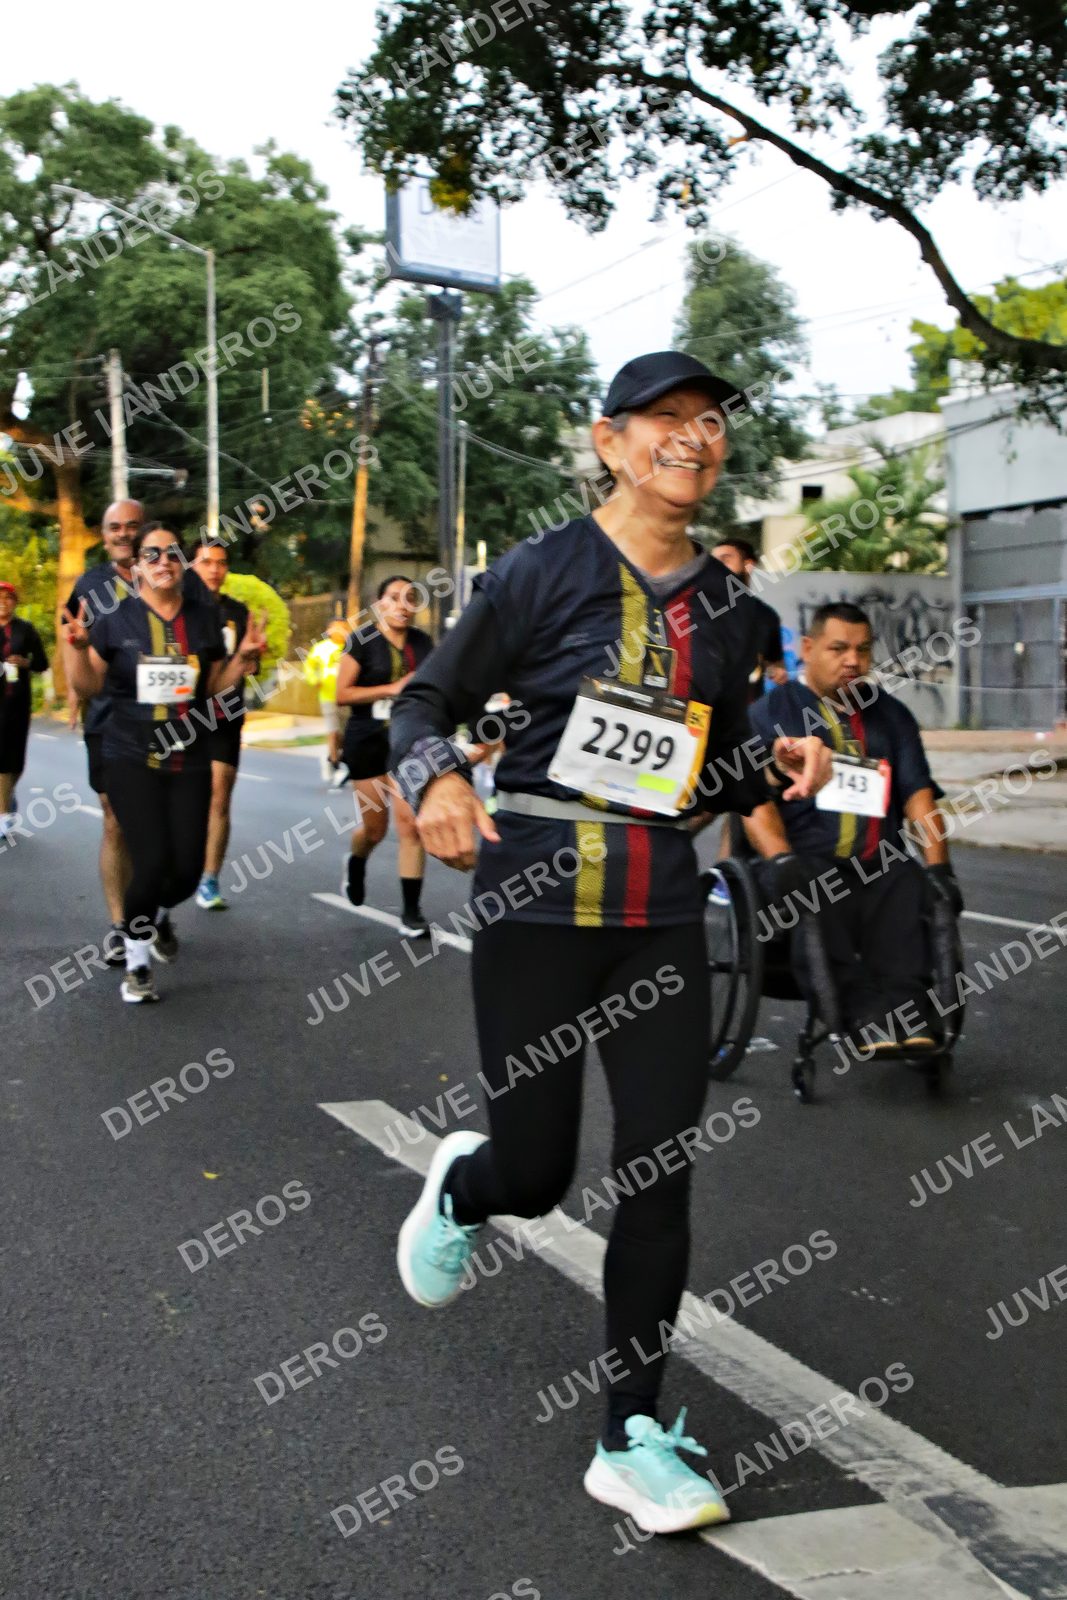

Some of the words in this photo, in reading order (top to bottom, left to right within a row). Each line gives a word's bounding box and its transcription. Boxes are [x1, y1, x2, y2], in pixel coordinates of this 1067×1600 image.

[147, 671, 187, 687] 5995
[580, 715, 675, 771] 2299
[837, 771, 868, 793] 143
